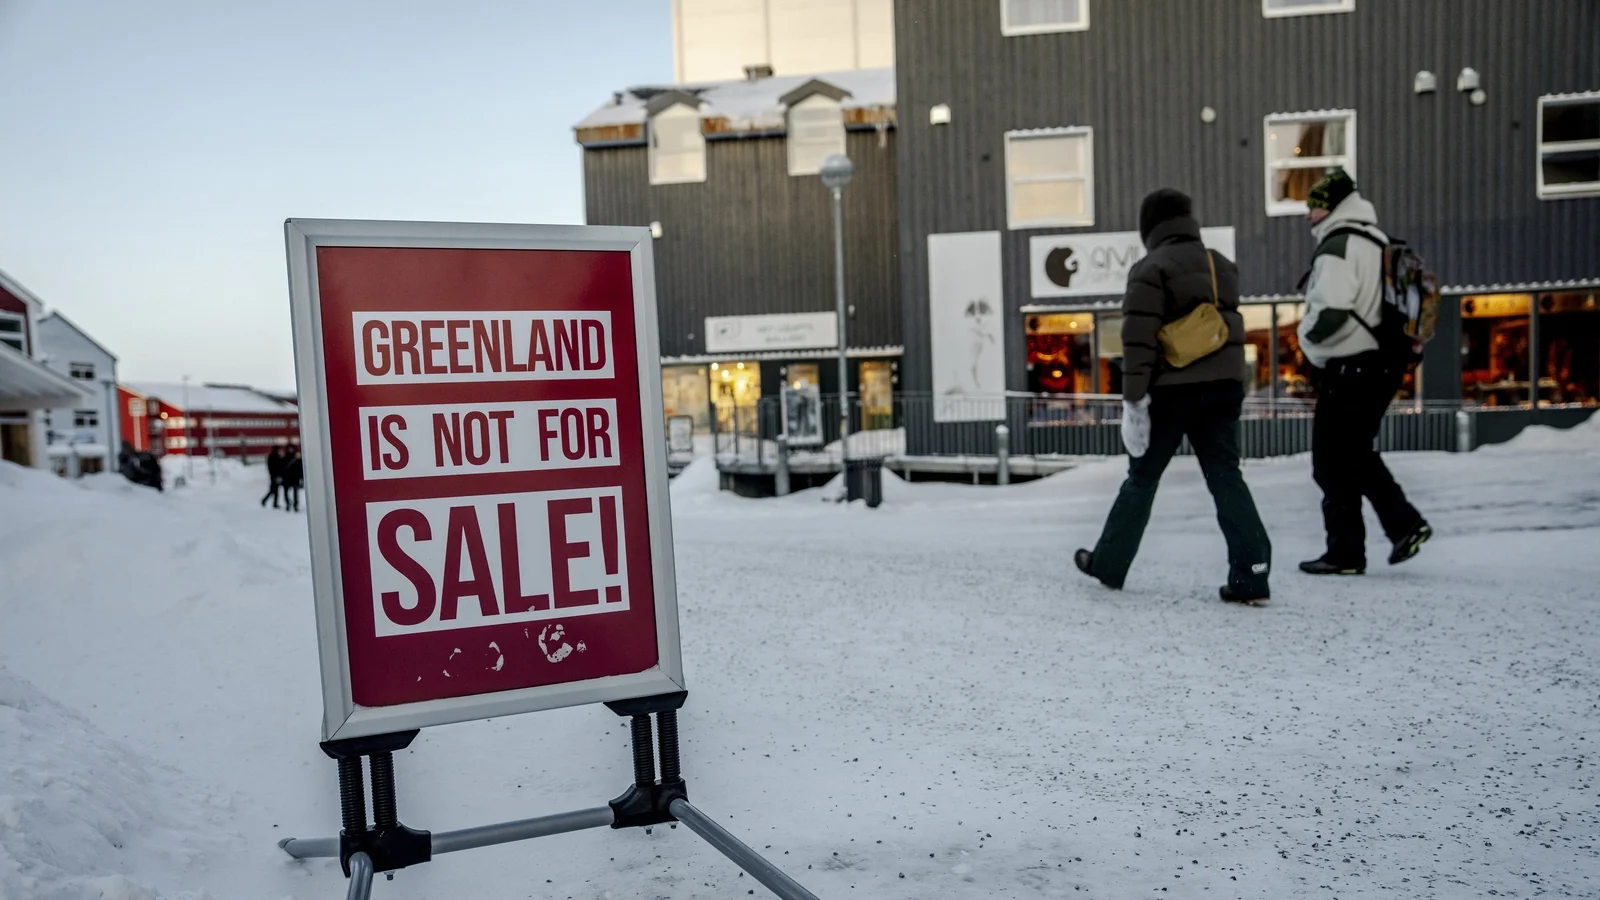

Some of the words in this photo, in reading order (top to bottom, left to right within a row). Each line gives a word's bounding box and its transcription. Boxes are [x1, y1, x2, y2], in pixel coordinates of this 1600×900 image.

[362, 319, 607, 377] GREENLAND
[367, 414, 409, 471] IS
[432, 410, 515, 467] NOT
[538, 407, 613, 461] FOR
[377, 495, 622, 626] SALE!
